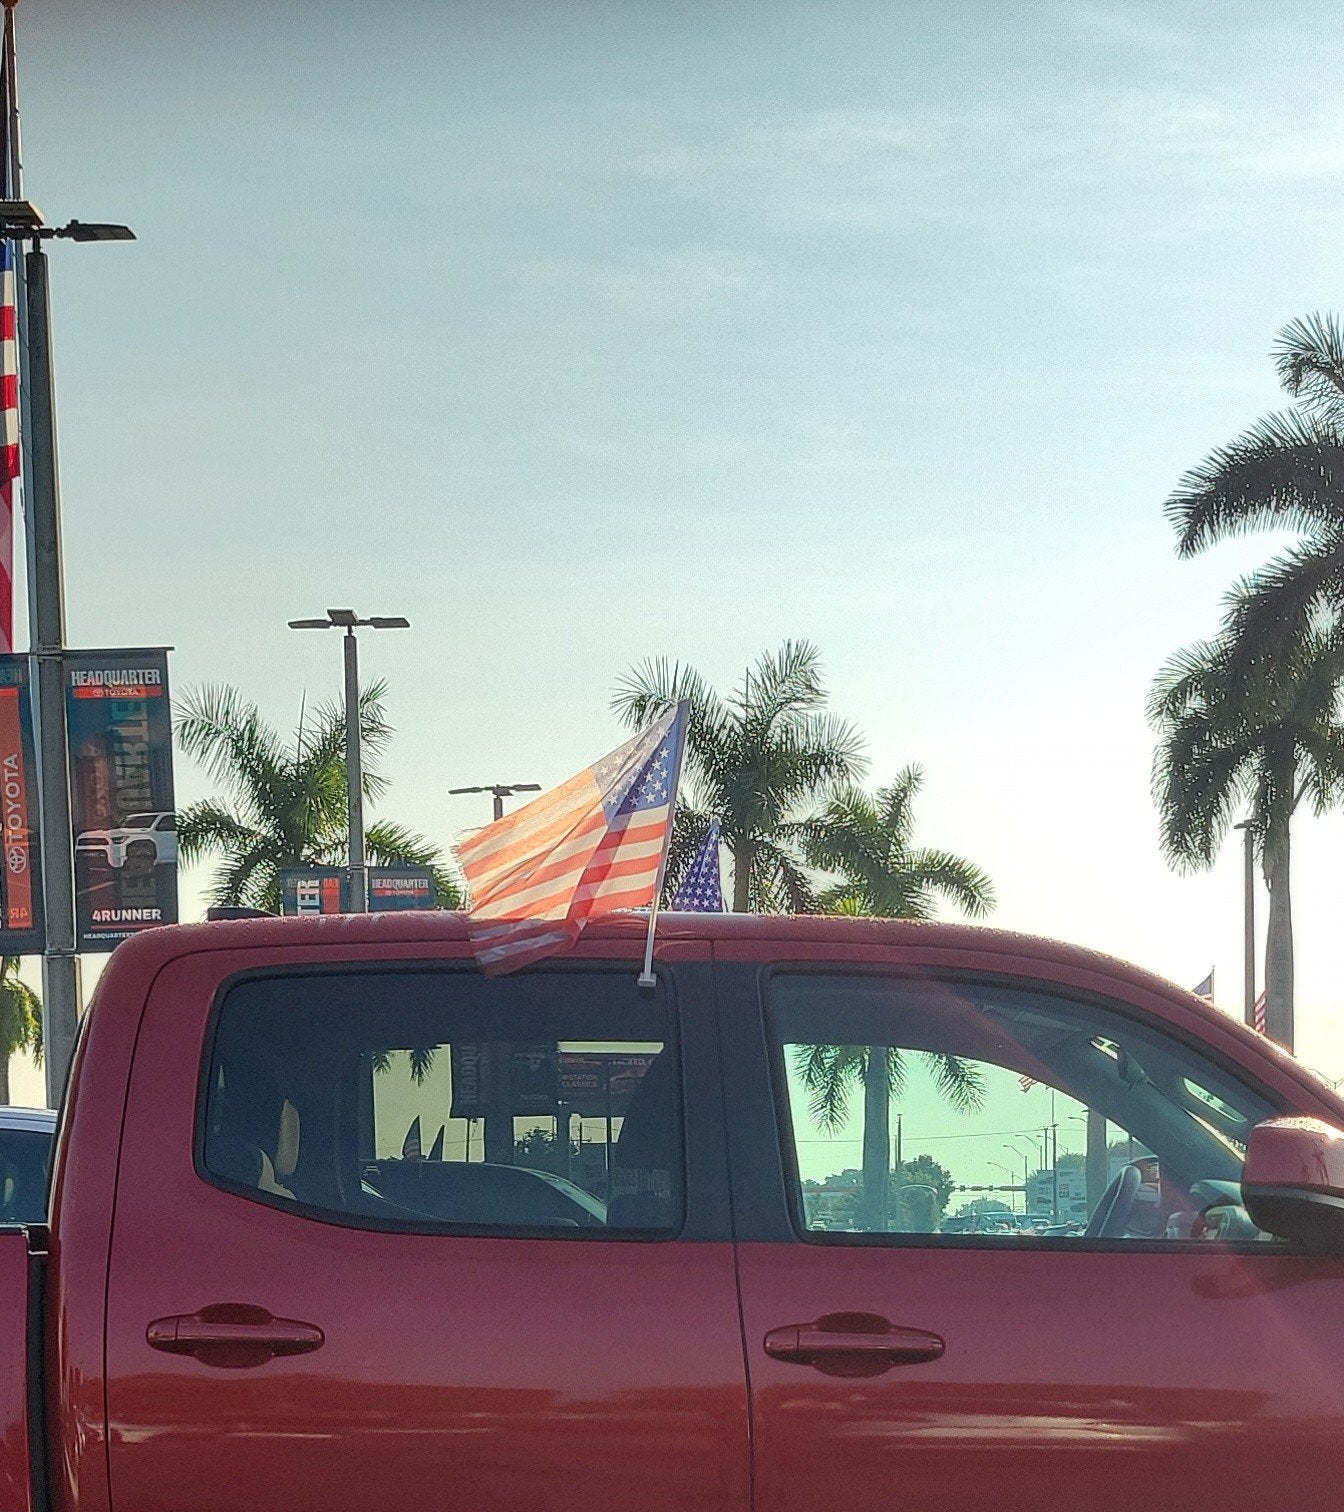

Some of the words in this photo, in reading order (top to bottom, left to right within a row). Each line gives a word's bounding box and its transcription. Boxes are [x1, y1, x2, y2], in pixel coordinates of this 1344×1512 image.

[71, 669, 161, 688] HEADQUARTER
[4, 753, 25, 845] TOYOTA
[371, 878, 428, 890] HEADQUARTER
[92, 908, 161, 922] 4RUNNER
